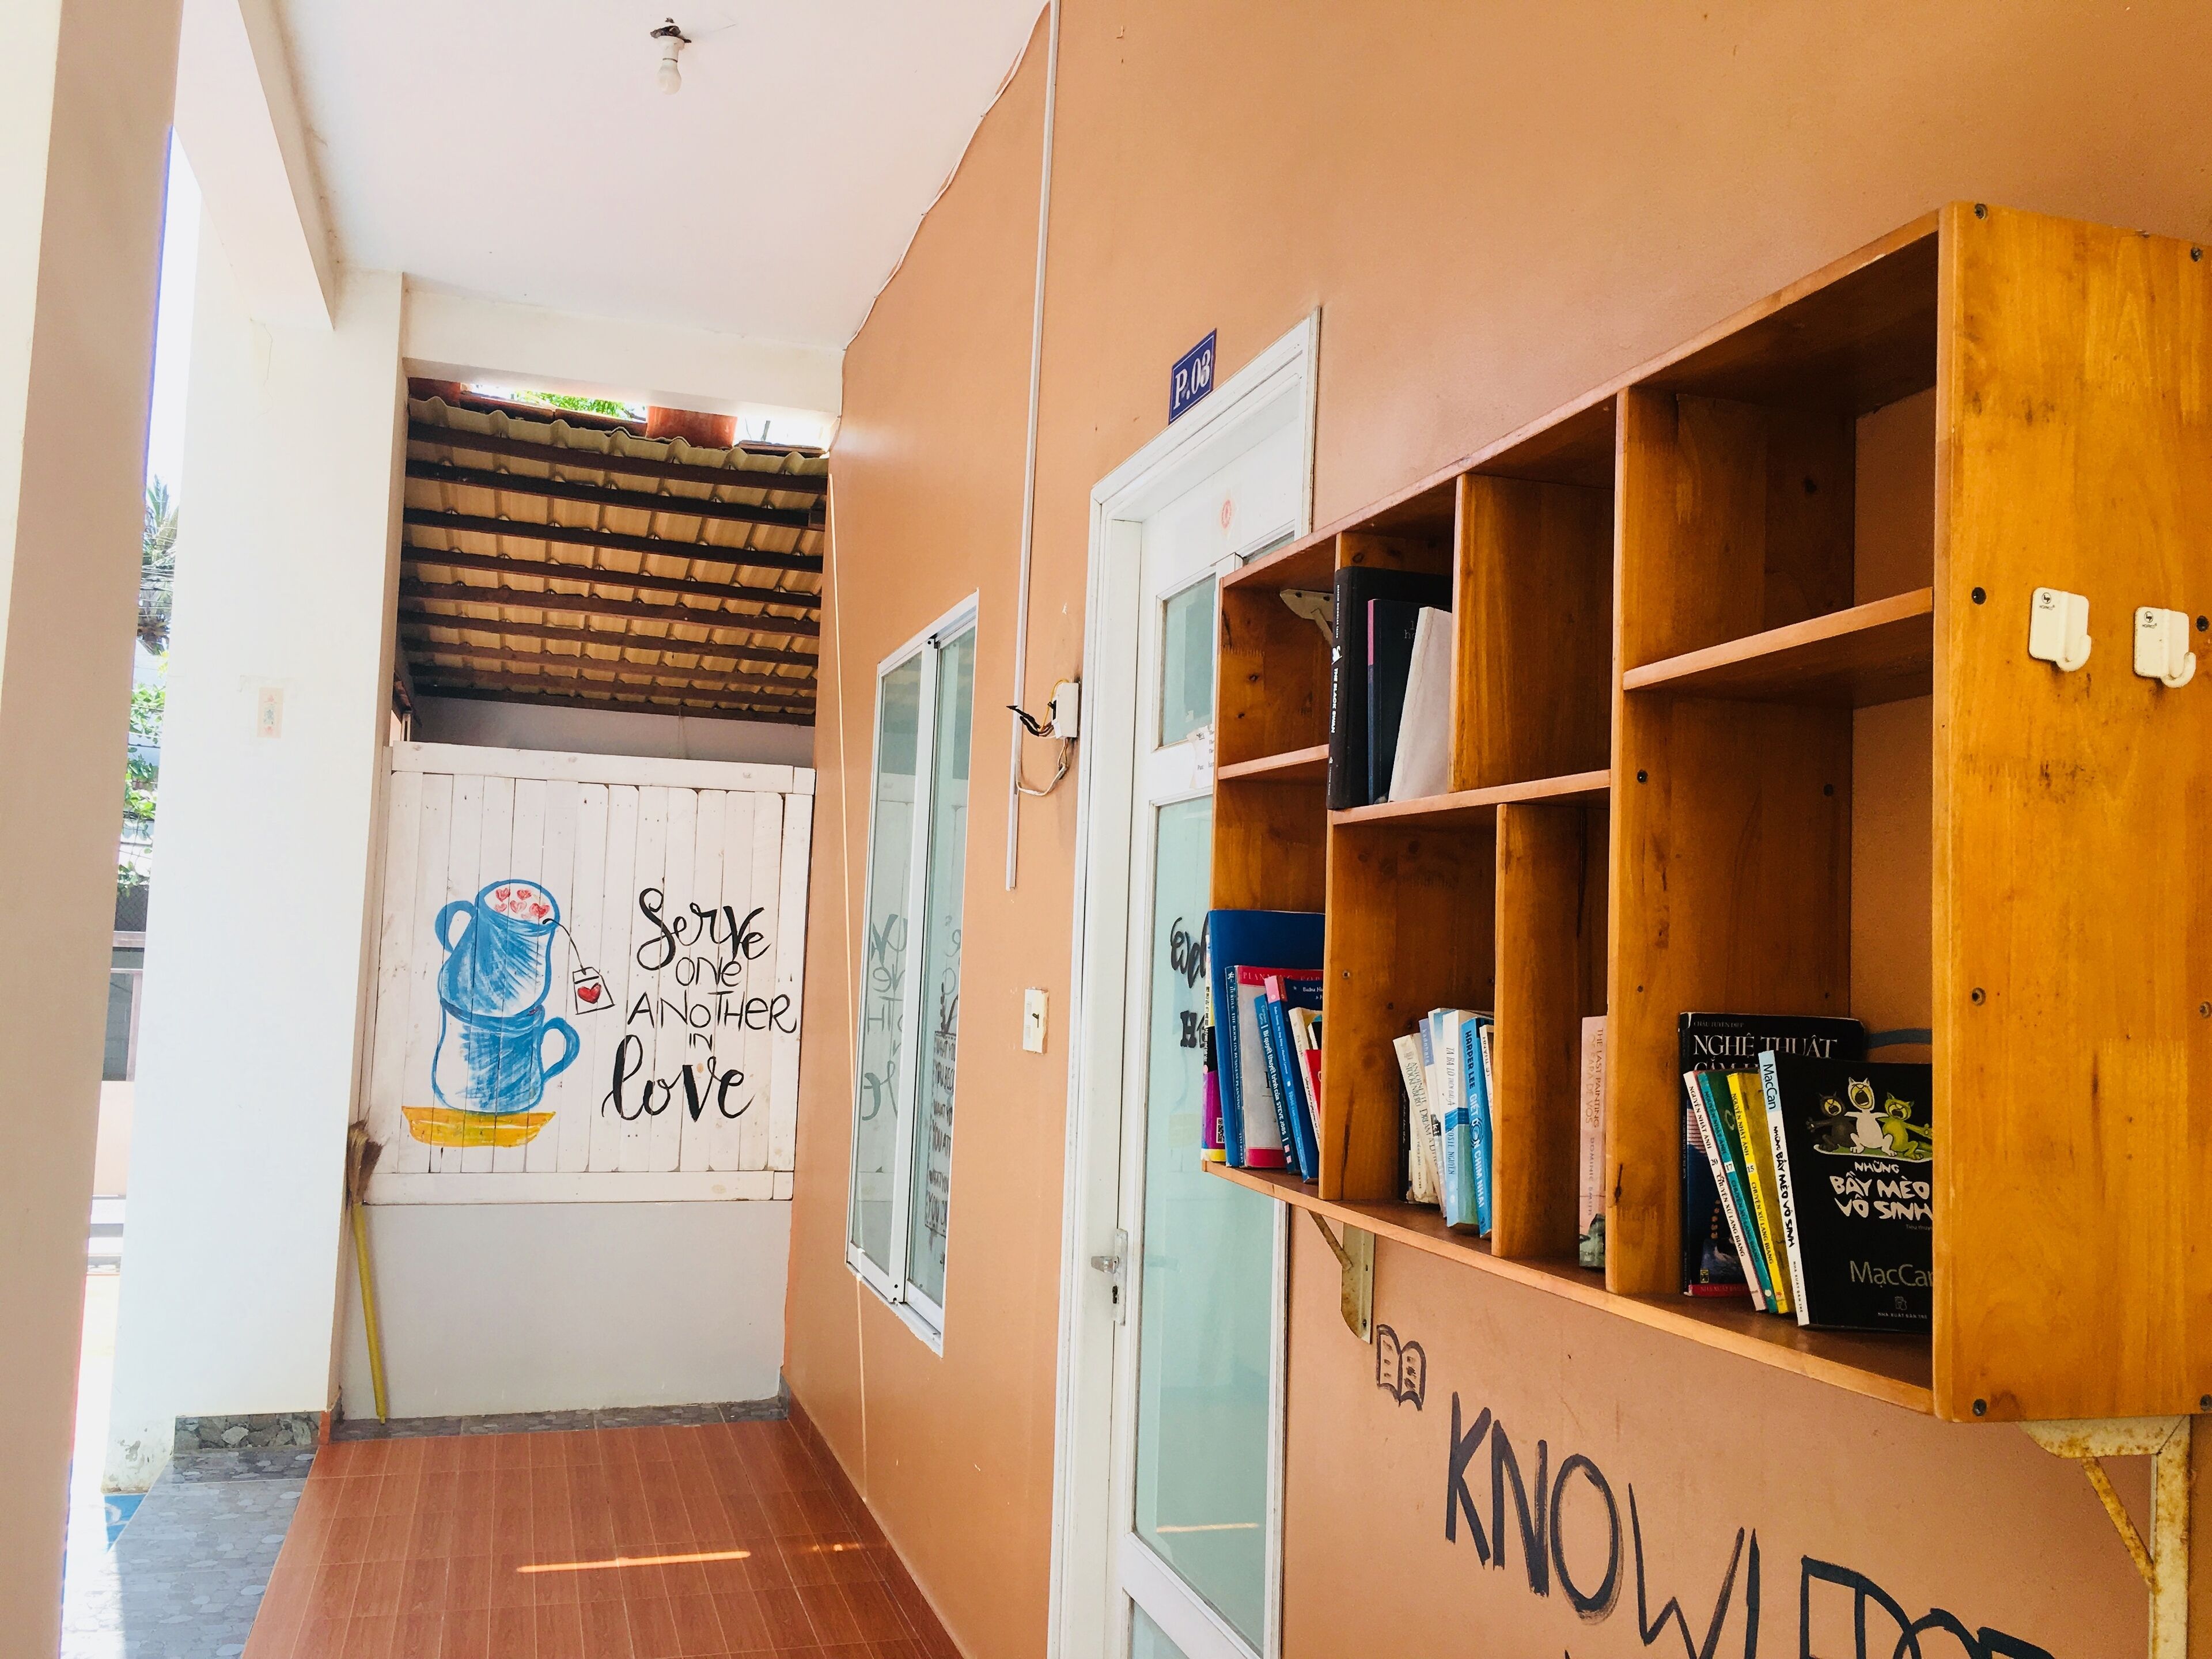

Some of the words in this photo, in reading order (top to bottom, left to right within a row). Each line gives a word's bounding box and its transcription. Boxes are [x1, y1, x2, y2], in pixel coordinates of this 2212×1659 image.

[1173, 350, 1211, 410] P.03
[637, 888, 772, 971] Serve
[689, 1033, 713, 1052] IN
[1464, 1030, 1475, 1070] HARPER
[1588, 1034, 1595, 1047] OF
[1694, 1033, 1755, 1058] NGHỆ
[1446, 1056, 1455, 1065] BA
[1586, 1084, 1593, 1096] DE
[1762, 1063, 1779, 1109] MạcCan
[1469, 1093, 1480, 1115] GIẾT
[1419, 1108, 1432, 1135] DREAM
[1474, 1150, 1483, 1179] CHIM
[1710, 1158, 1718, 1166] 20
[1725, 1163, 1733, 1171] 17
[1747, 1165, 1754, 1173] 15
[1779, 1173, 1790, 1199] MÈO
[1877, 1176, 1930, 1200] MÈO
[1782, 1200, 1793, 1217] VÔ
[1834, 1194, 1869, 1218] VÔ
[1873, 1200, 1933, 1221] SINH
[1728, 1215, 1738, 1234] LANG
[1734, 1234, 1745, 1256] BIANG
[1760, 1222, 1768, 1241] LANG
[1764, 1242, 1772, 1264] BIANG
[1785, 1218, 1795, 1247] SINH
